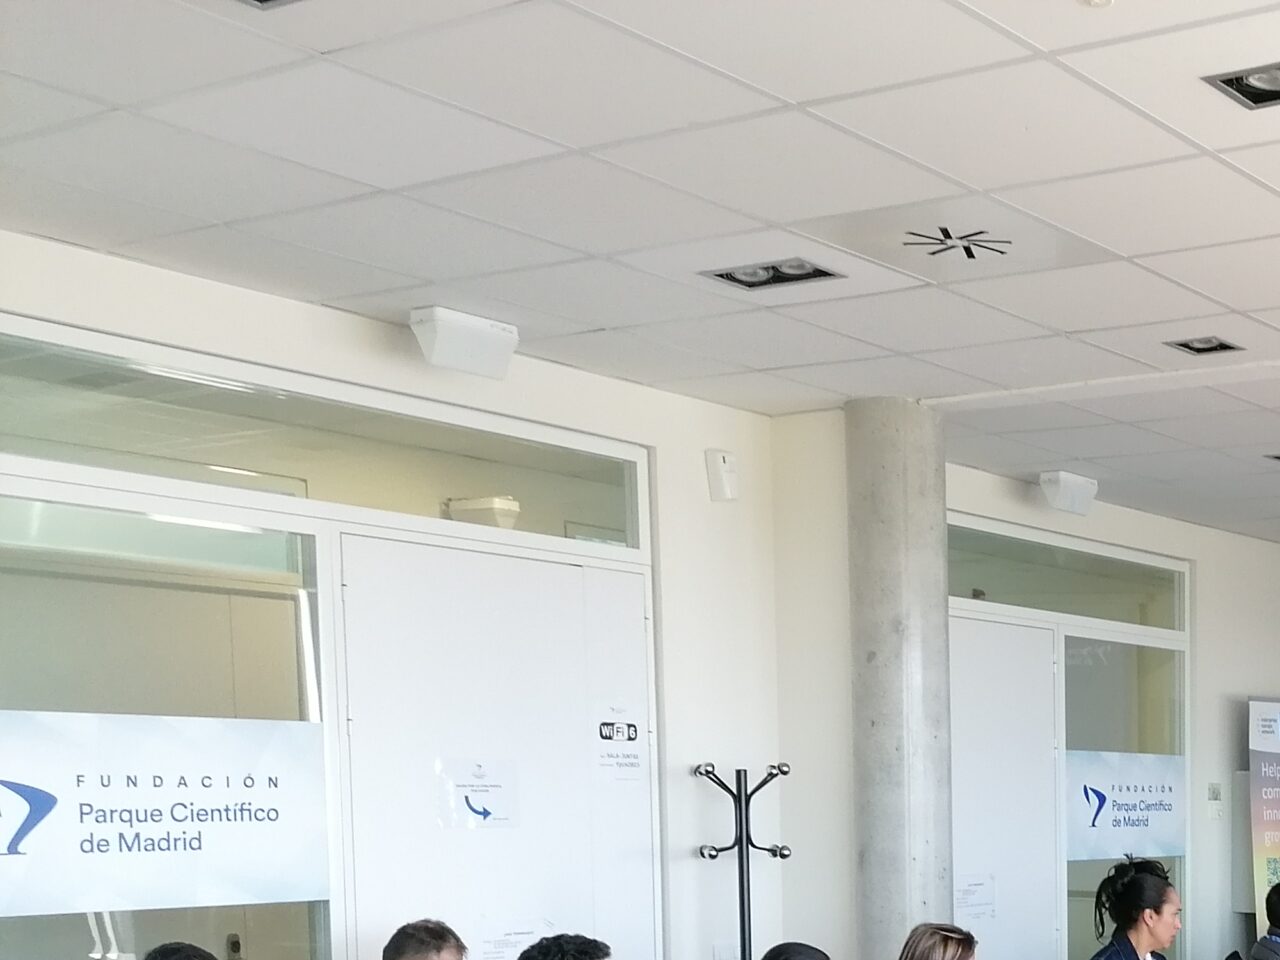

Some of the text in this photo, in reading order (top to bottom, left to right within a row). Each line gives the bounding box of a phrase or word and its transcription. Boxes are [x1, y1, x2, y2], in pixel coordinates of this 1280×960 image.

[76, 773, 279, 789] FUNDACIÓN
[1111, 784, 1173, 793] FUNDACIÓN
[1111, 799, 1173, 814] Parque Científico
[78, 802, 280, 828] Parque Científico
[1111, 815, 1149, 828] de Madrid
[79, 830, 203, 854] de Madrid
